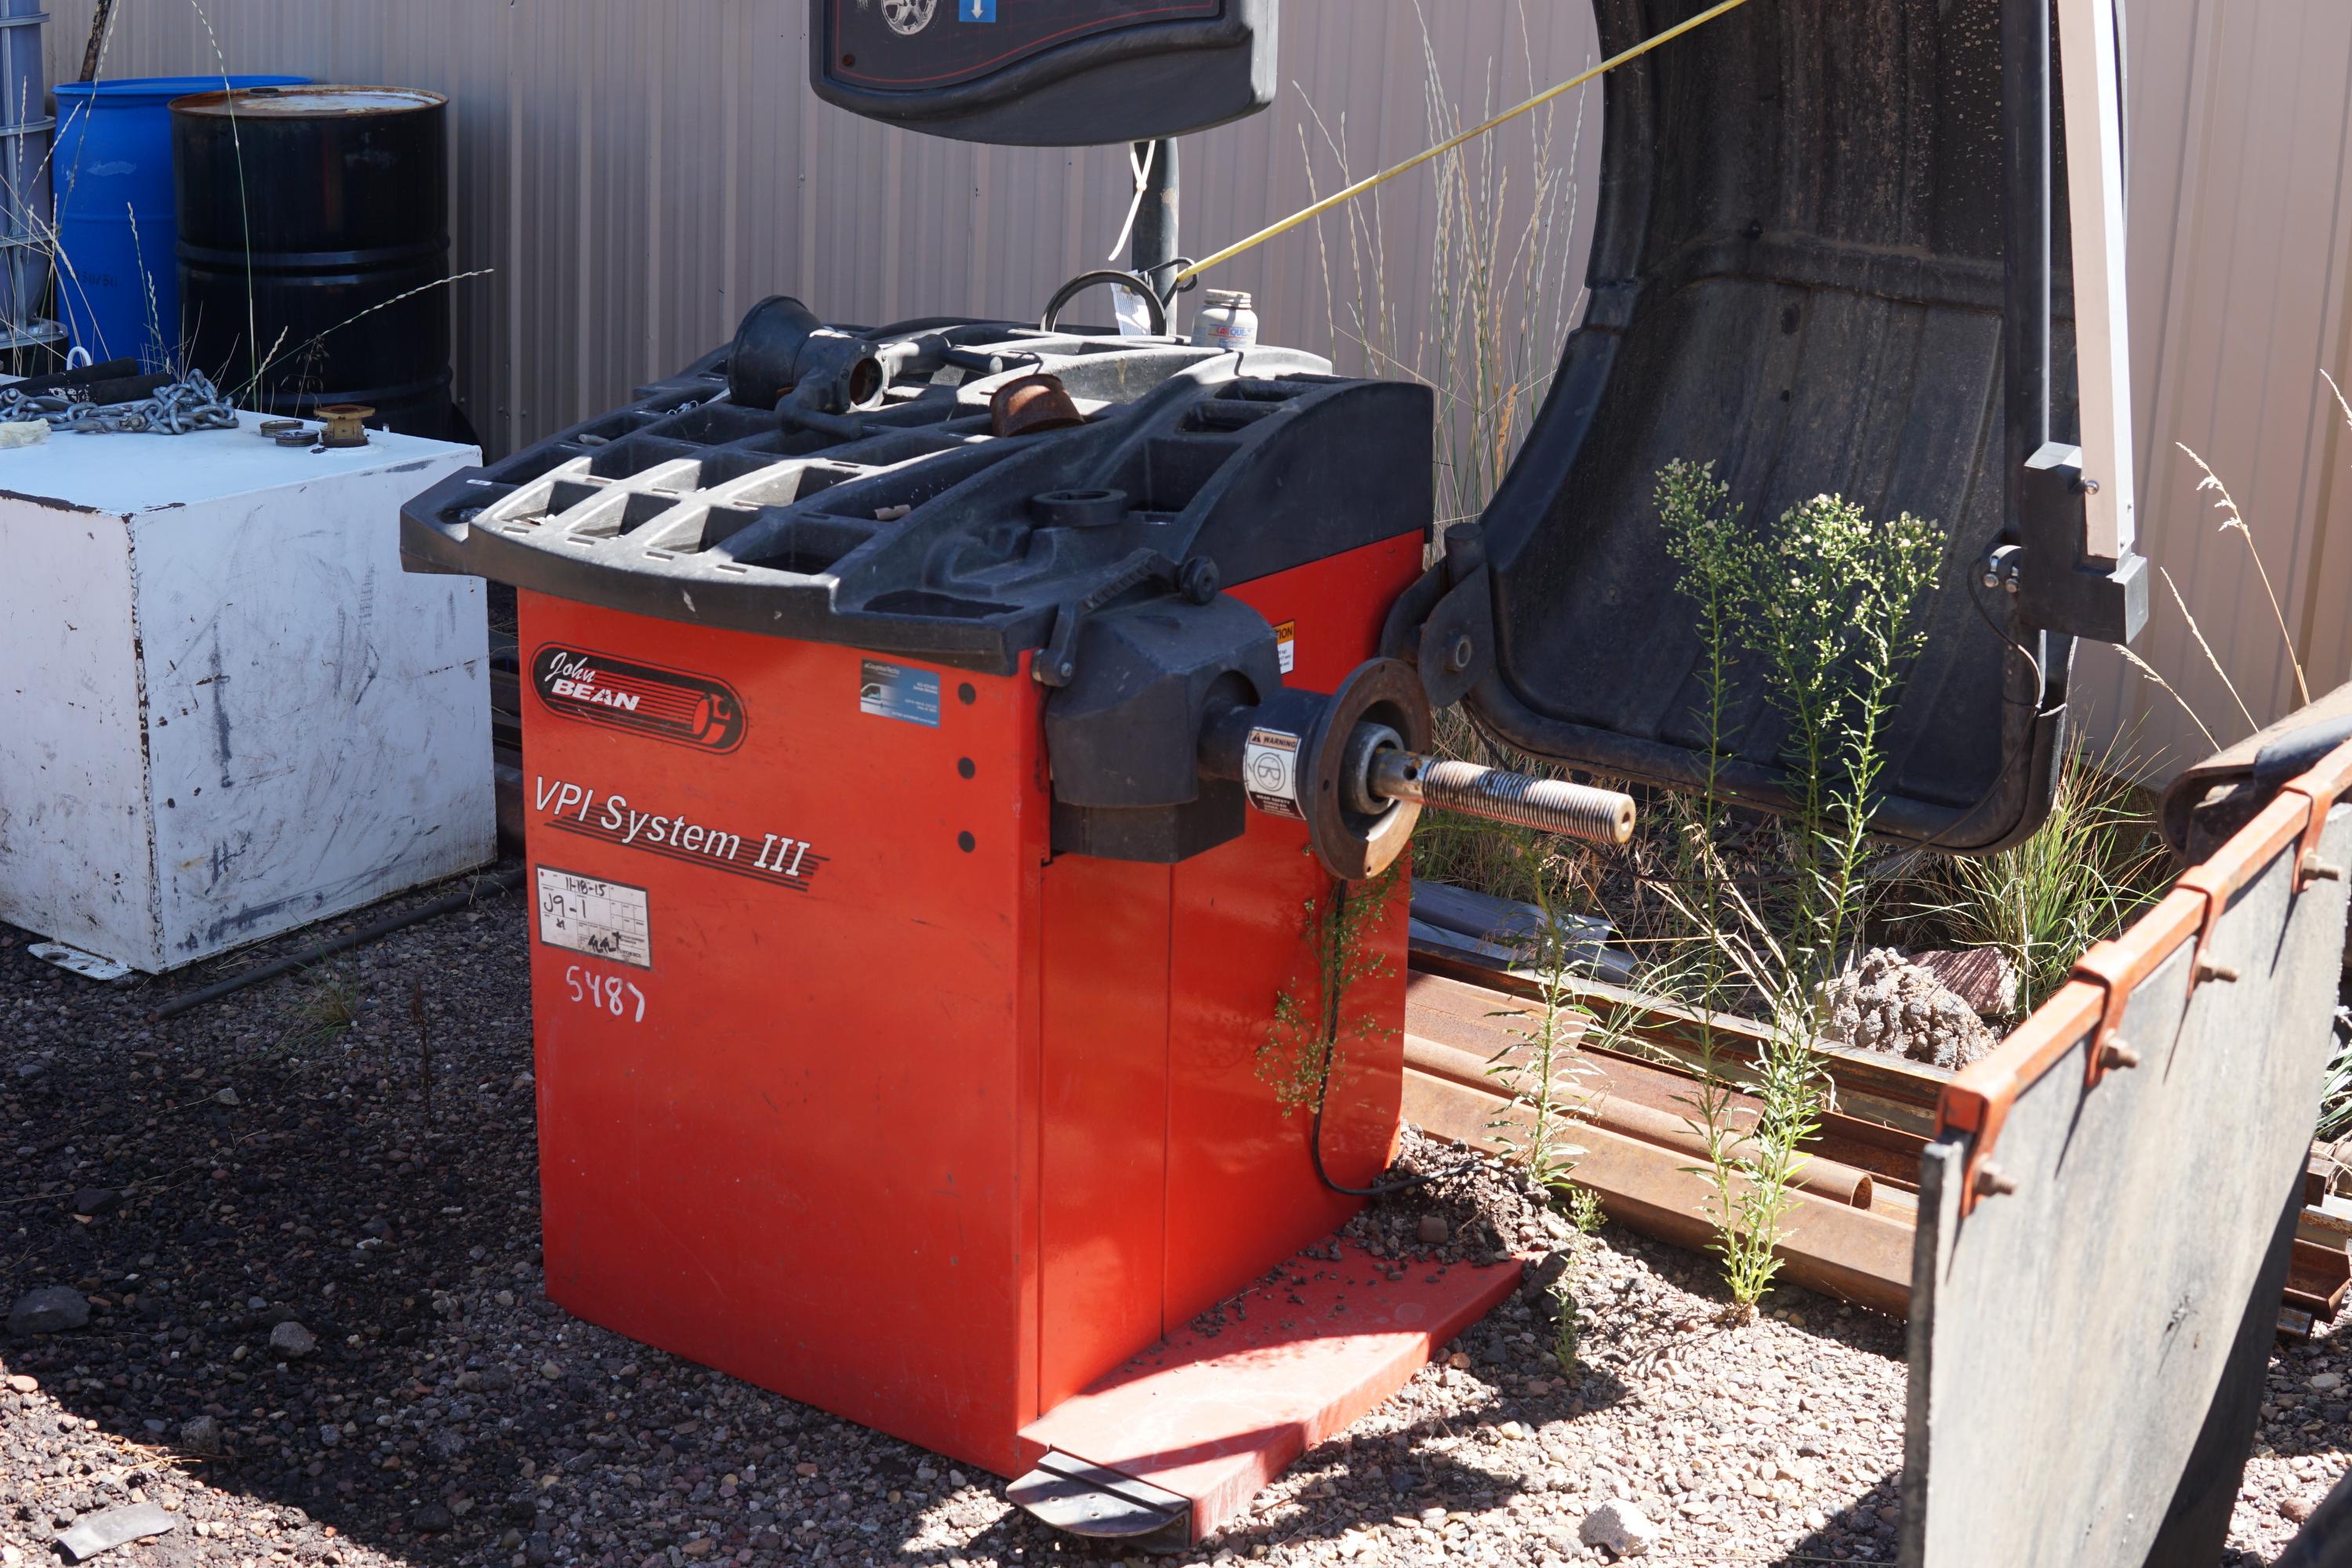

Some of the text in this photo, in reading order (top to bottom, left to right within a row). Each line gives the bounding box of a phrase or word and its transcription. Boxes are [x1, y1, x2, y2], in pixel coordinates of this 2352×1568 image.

[544, 652, 596, 683] John
[551, 678, 641, 711] BEAN
[1263, 737, 1297, 748] WARNING
[535, 775, 811, 877] VPI System III
